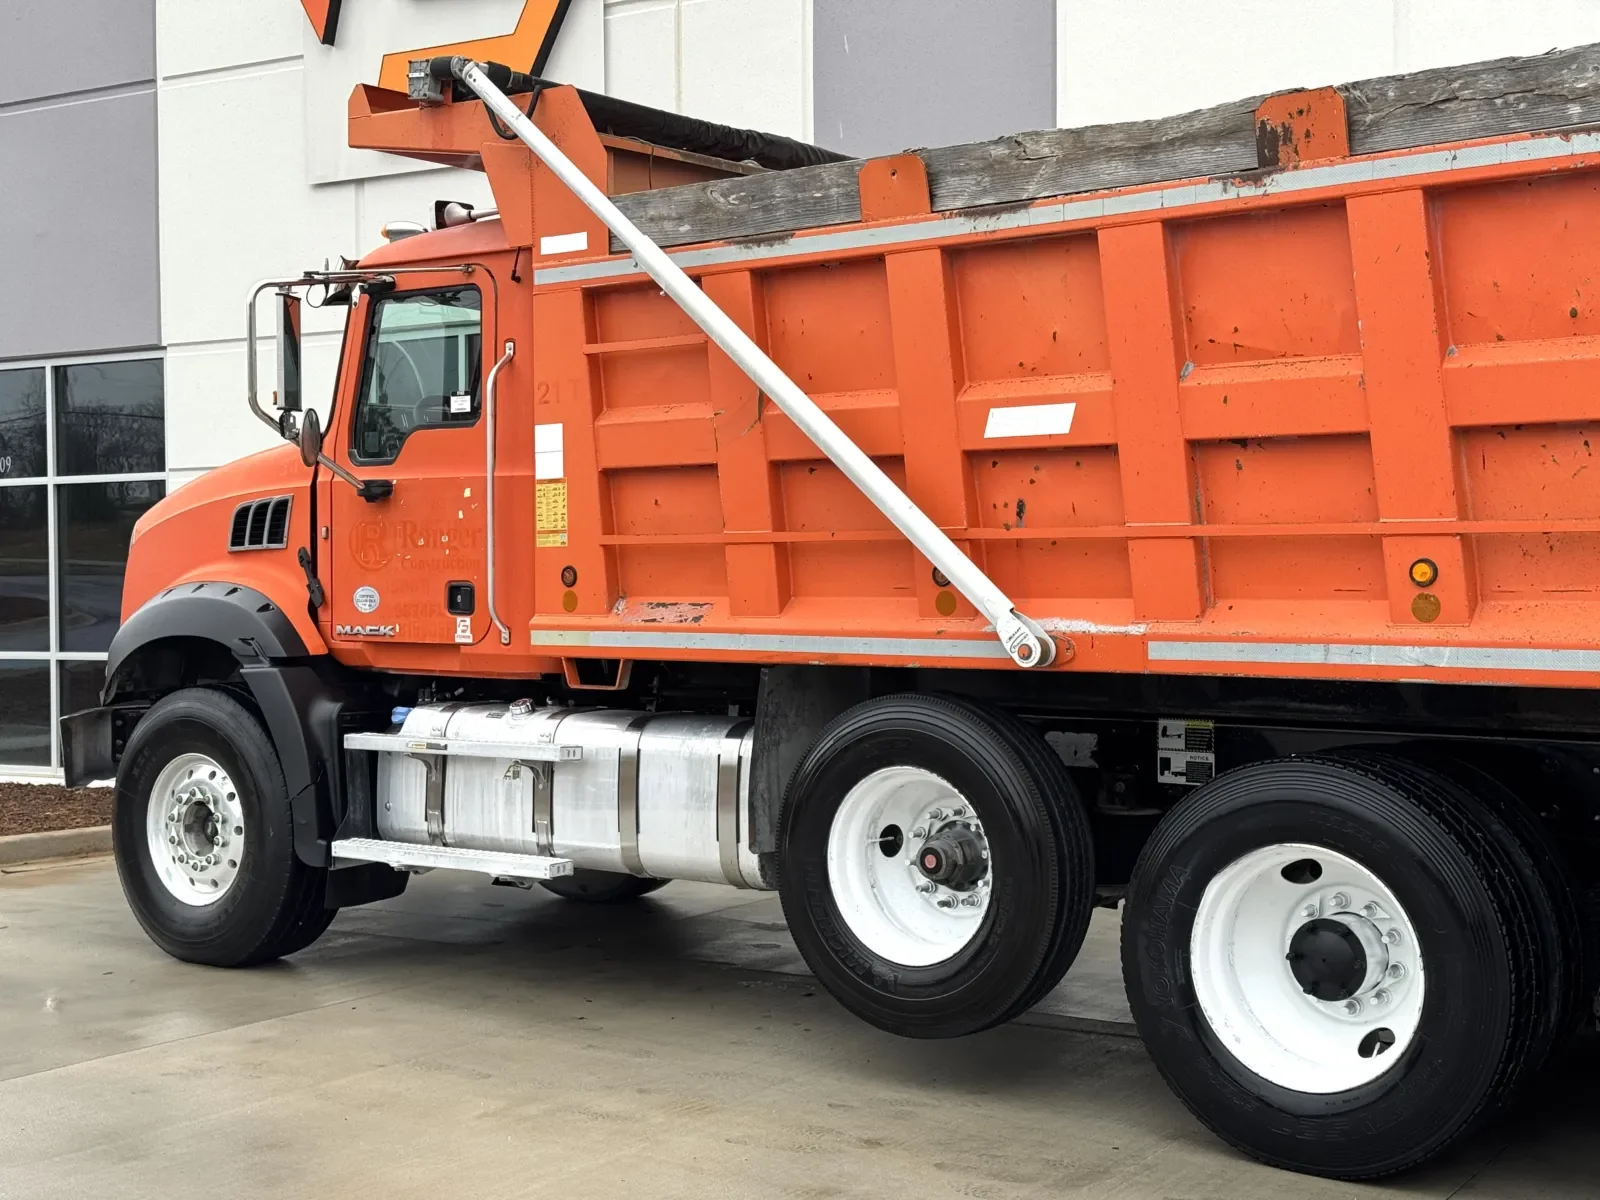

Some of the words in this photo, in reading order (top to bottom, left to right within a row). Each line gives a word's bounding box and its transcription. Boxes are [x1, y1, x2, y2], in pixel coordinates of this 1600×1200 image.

[398, 519, 483, 556] Ranger
[400, 557, 481, 571] Construction
[335, 624, 396, 637] MACK
[1146, 865, 1190, 1006] YOKOHAMA
